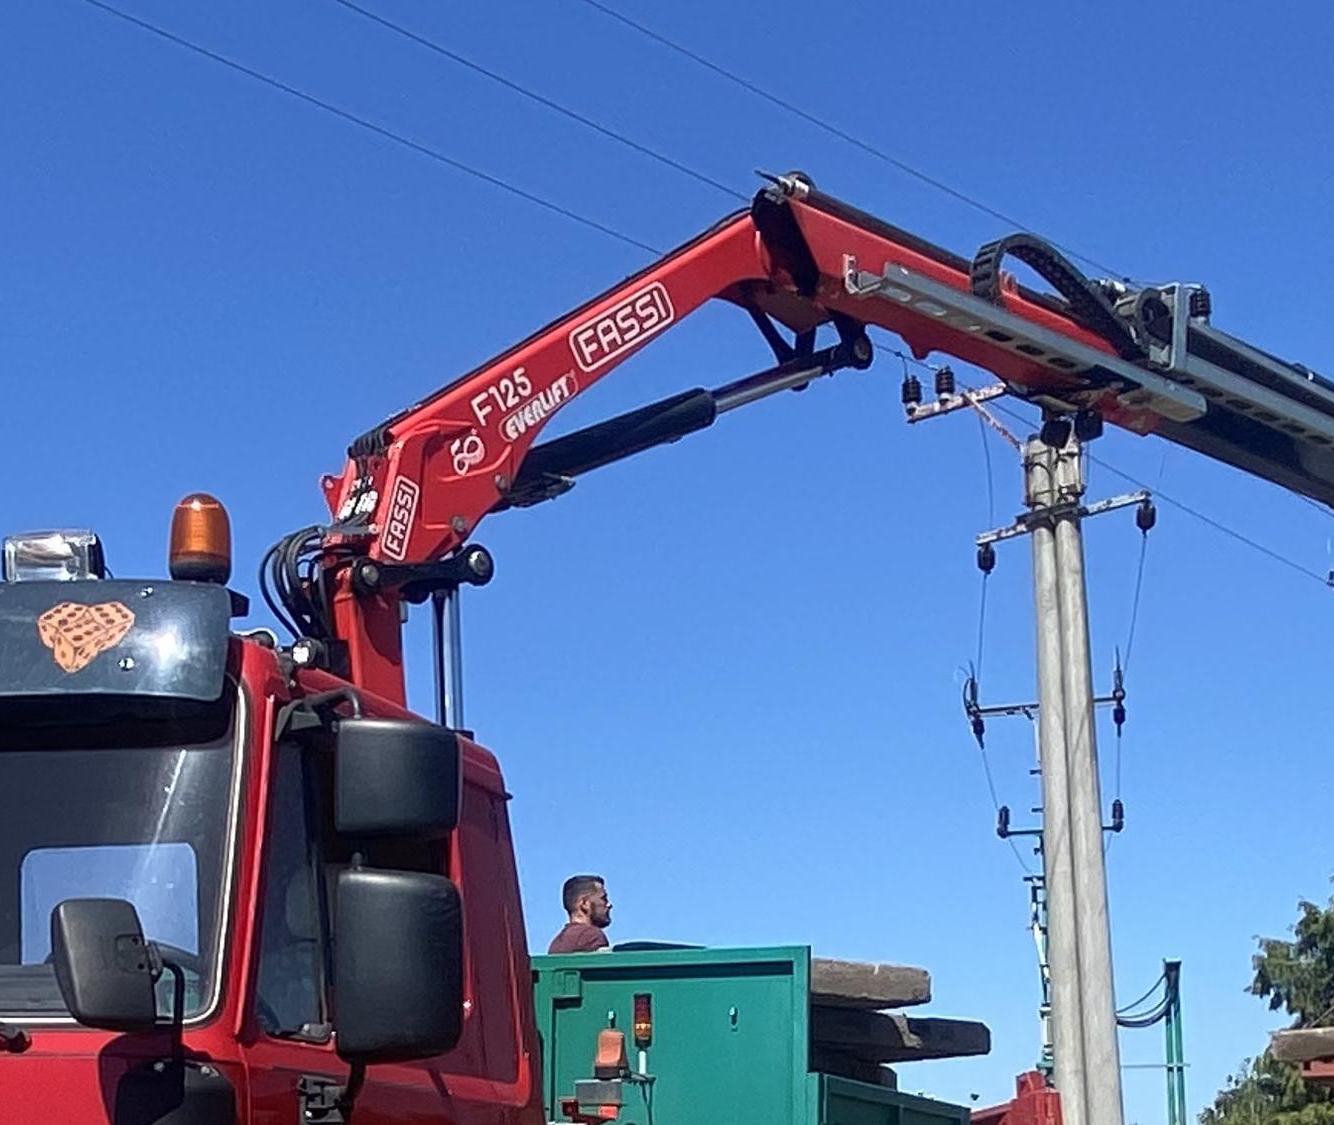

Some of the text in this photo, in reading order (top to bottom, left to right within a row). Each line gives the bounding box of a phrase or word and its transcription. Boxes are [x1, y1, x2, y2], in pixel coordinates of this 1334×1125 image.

[576, 290, 667, 364] FASSI
[470, 367, 533, 426] F125
[386, 482, 415, 552] FASSI
